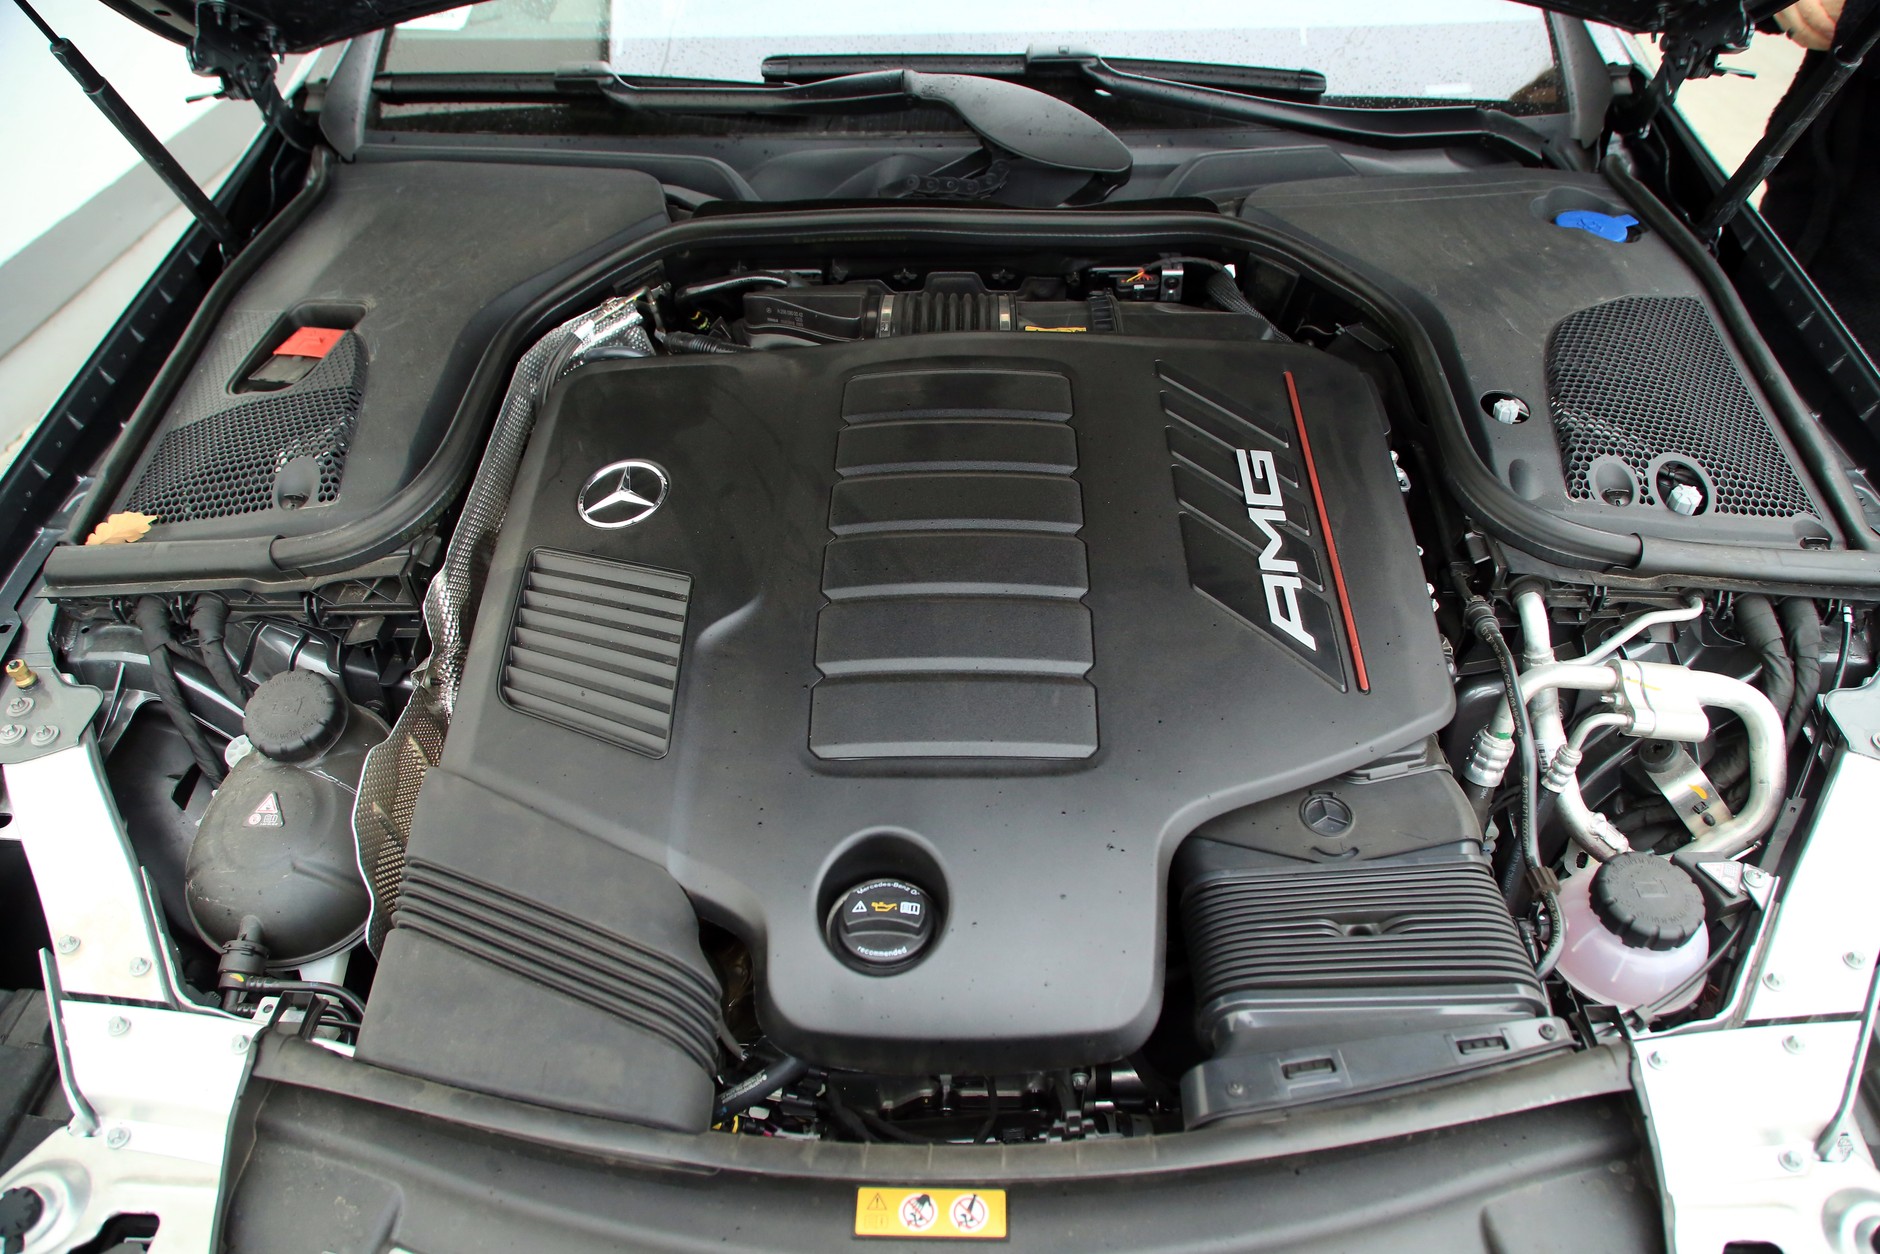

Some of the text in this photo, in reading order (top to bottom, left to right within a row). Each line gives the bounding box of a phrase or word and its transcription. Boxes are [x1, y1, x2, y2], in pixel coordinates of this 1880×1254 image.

[1236, 449, 1316, 651] AMG
[856, 882, 910, 894] Mercedes-Benz
[857, 945, 907, 957] recommended
